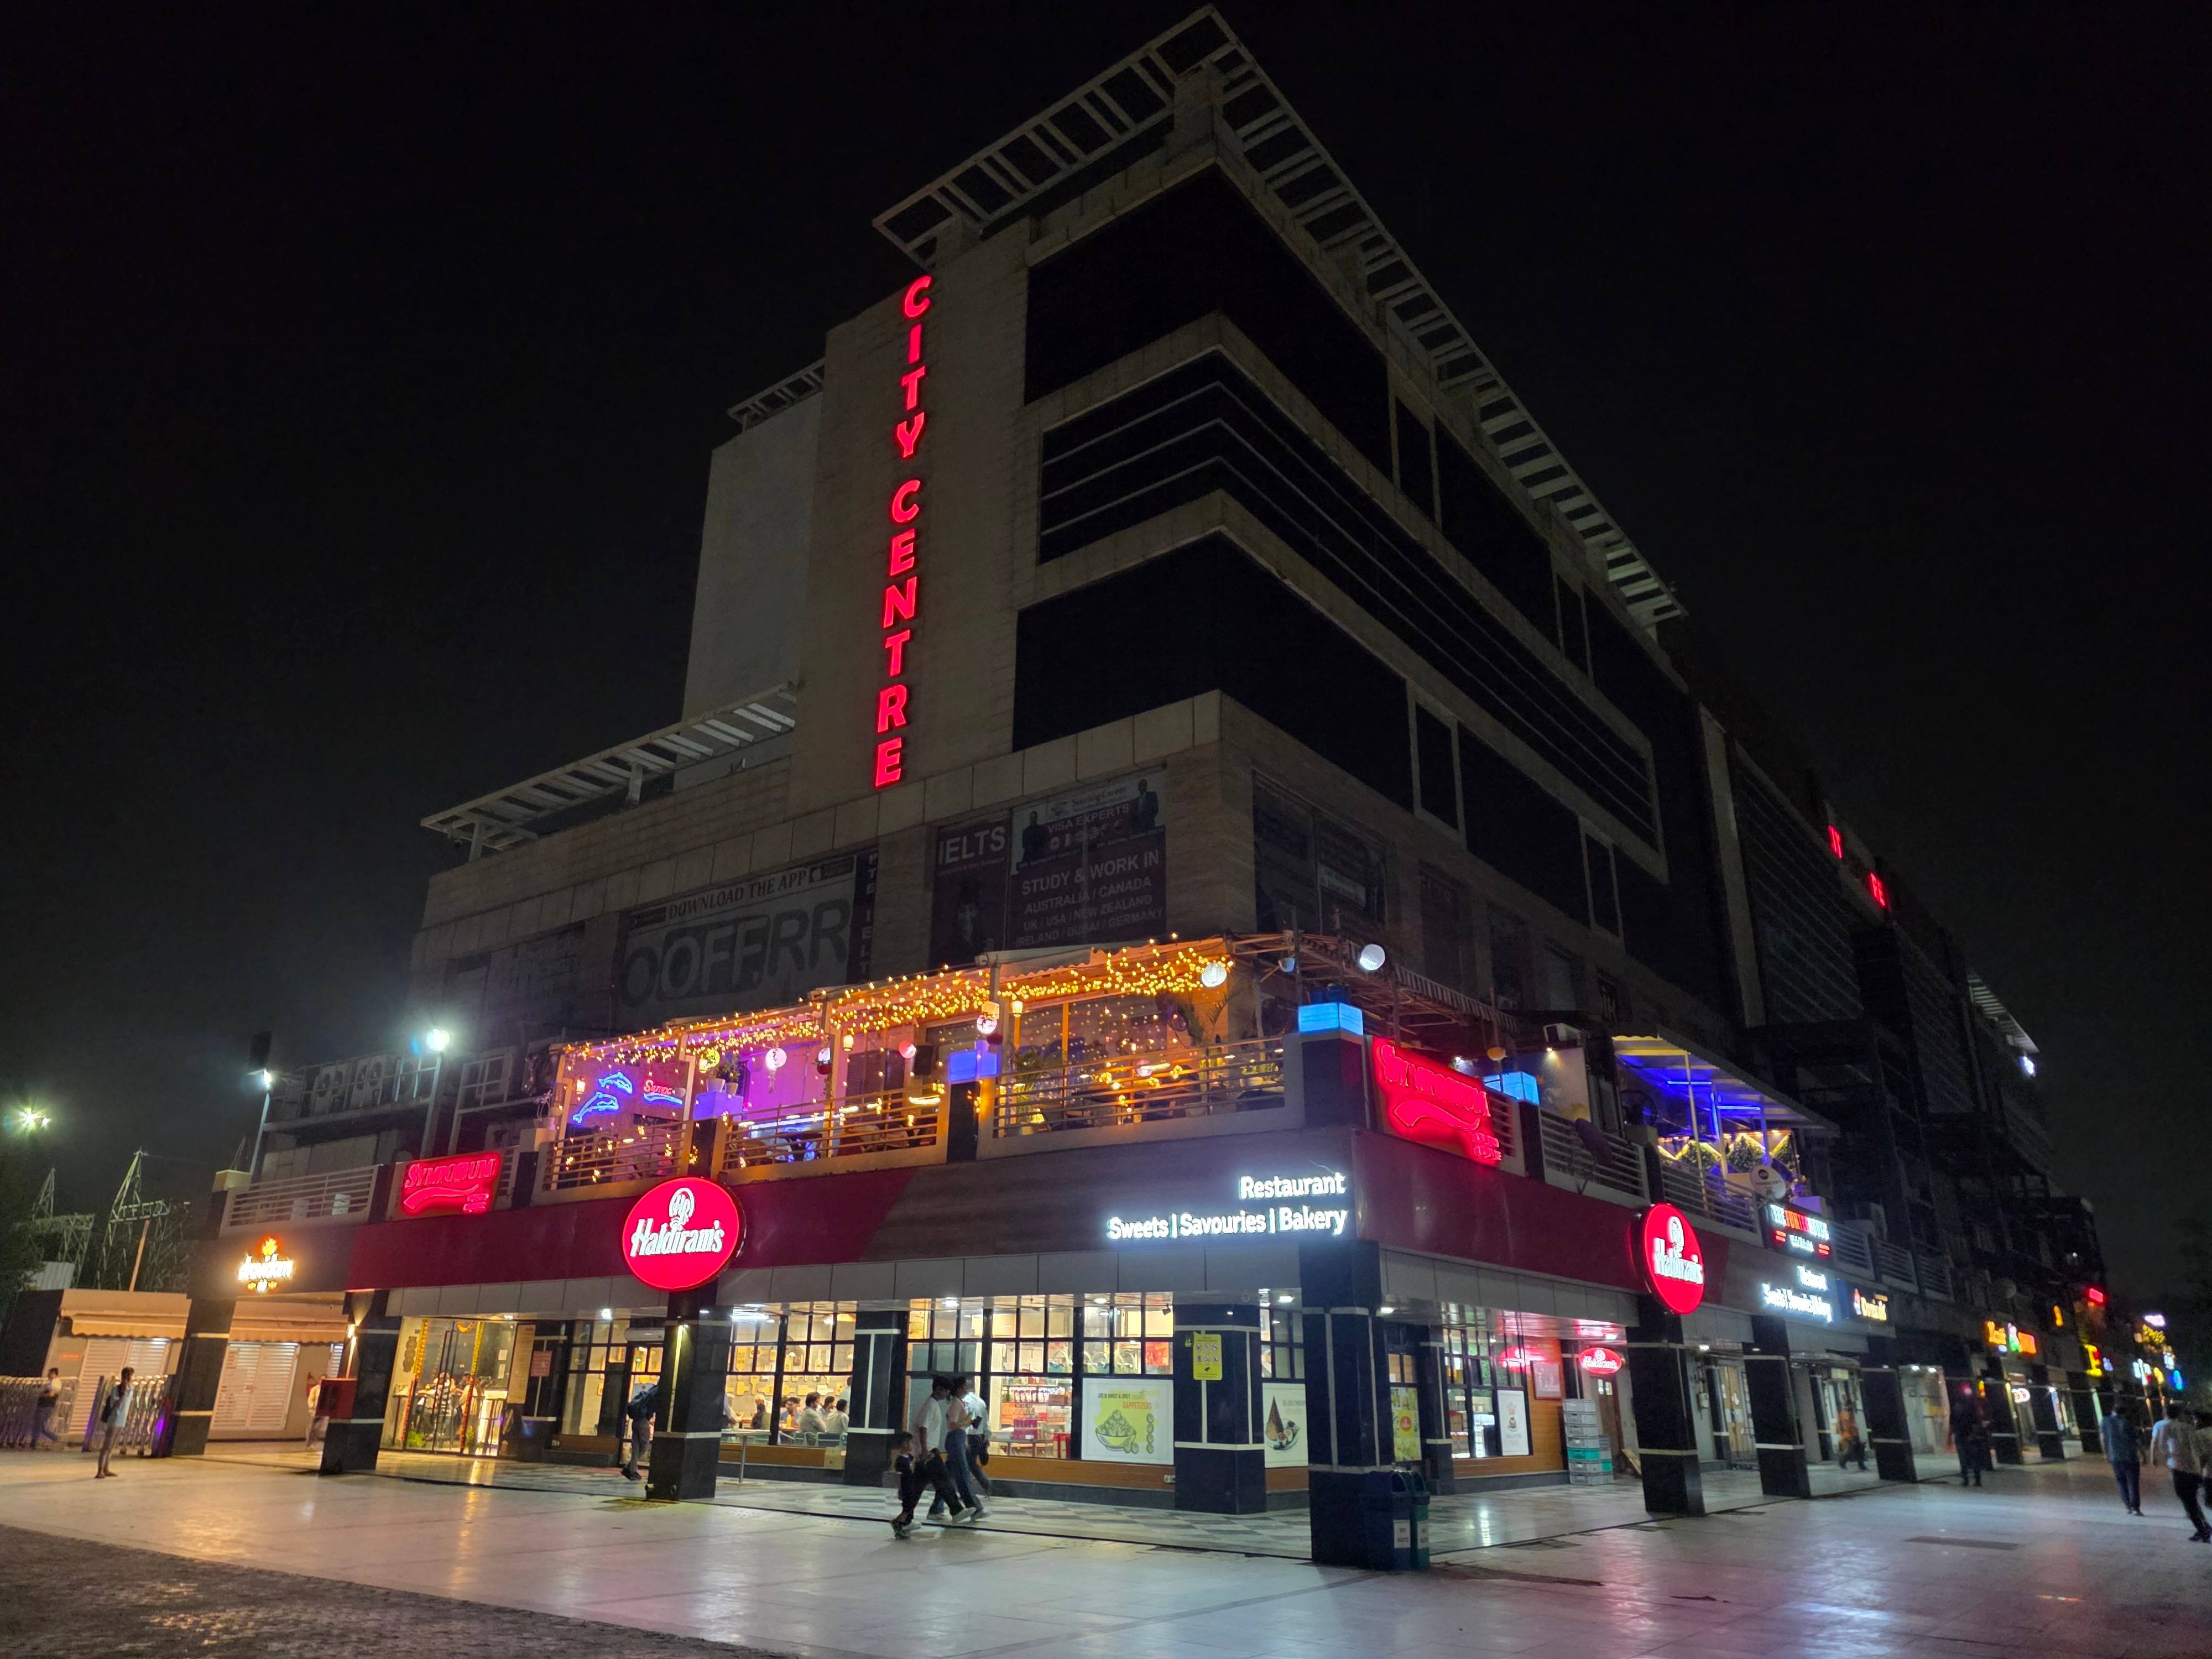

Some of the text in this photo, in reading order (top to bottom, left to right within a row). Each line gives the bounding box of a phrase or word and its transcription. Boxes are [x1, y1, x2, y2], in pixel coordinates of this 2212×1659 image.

[876, 275, 931, 788] CITY CENTRE
[1047, 819, 1073, 833] VISA
[1076, 804, 1129, 826] EXPERTS
[938, 826, 1005, 864] IELTS
[1022, 870, 1070, 895] STUDY
[1089, 858, 1139, 880] WORK
[1144, 849, 1159, 867] IN
[669, 886, 743, 920] DOWNLOAD
[748, 880, 775, 898] THE
[778, 870, 807, 890] APP
[1024, 920, 1038, 931] UK
[1046, 912, 1066, 927] USA
[1074, 906, 1096, 922] NEW
[1100, 894, 1153, 915] ZEALAND
[1025, 890, 1090, 915] AUSTRALIA
[1099, 877, 1151, 897] CANADA
[1016, 928, 1059, 947] IRELAND
[1067, 921, 1100, 938] DUBAI
[1108, 907, 1162, 928] GERMANY
[1239, 1172, 1347, 1199] Restaurant
[630, 1217, 725, 1257] Haldiram's
[1107, 1216, 1168, 1239] Sweets
[1180, 1210, 1266, 1236] Savouries
[1279, 1205, 1348, 1235] Bakery
